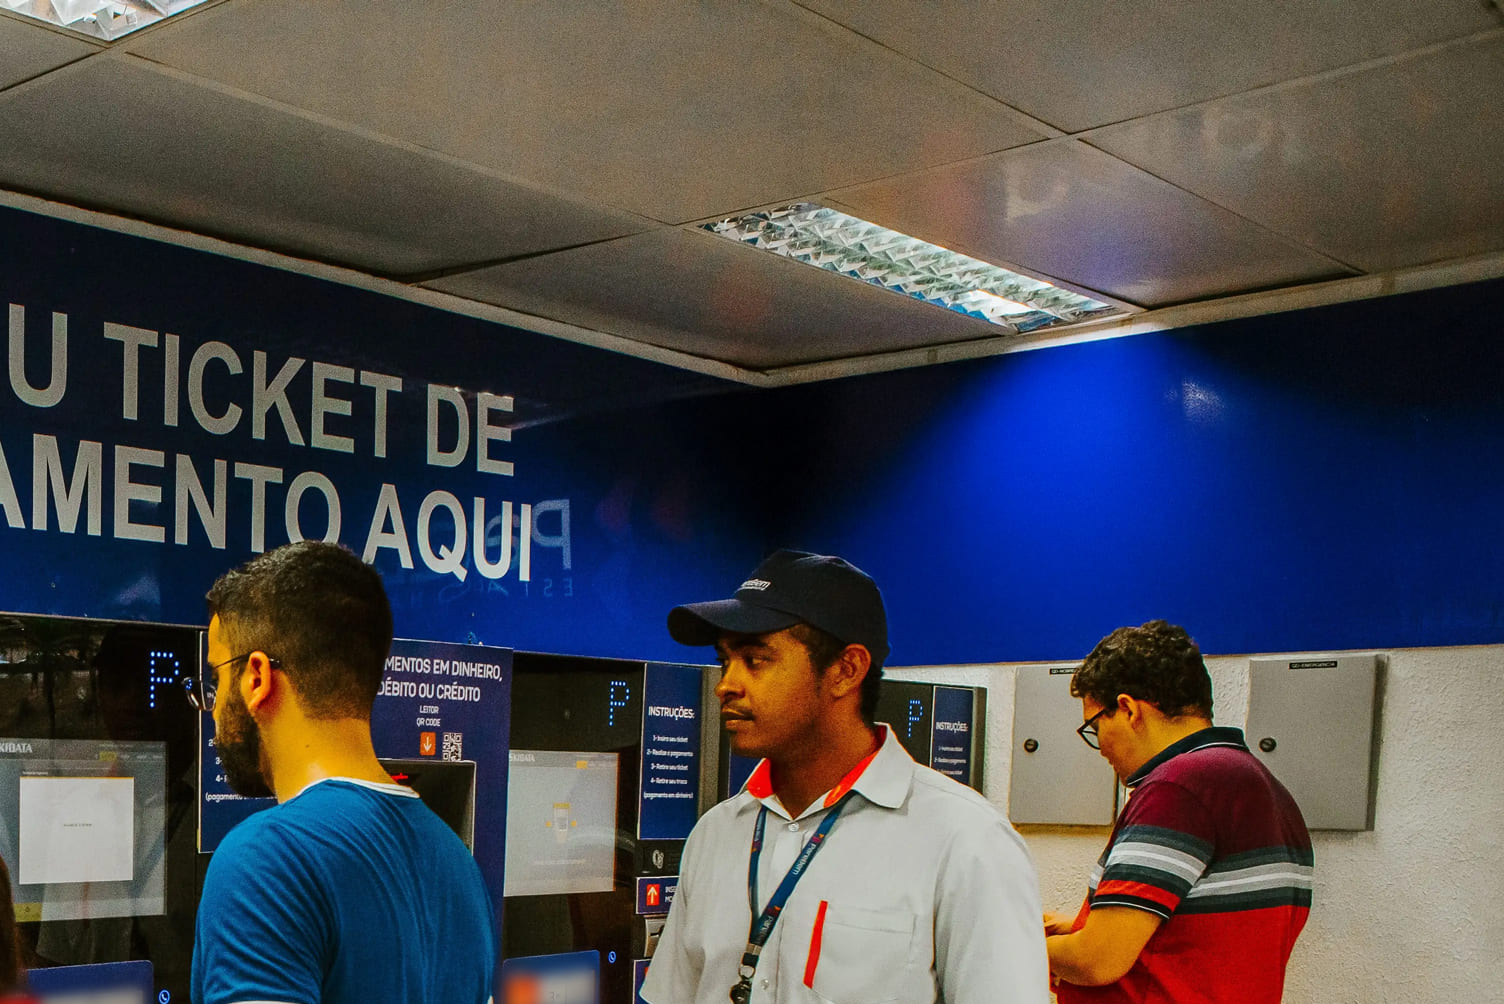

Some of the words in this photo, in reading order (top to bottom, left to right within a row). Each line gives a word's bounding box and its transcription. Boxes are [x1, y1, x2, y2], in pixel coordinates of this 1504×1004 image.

[103, 321, 403, 459] TICKET
[426, 383, 516, 477] DE
[362, 483, 532, 583] AQUI
[150, 651, 180, 709] P
[384, 656, 431, 674] MENTOS
[433, 659, 450, 676] EM
[451, 661, 503, 682] DINHEIRO,
[419, 683, 435, 699] OU
[436, 681, 481, 702] CRÉDITO
[608, 681, 630, 727] P
[416, 717, 425, 727] QR
[426, 718, 441, 727] CODE
[419, 705, 439, 714] LEITOR
[648, 706, 695, 720] INSTRUÇÕES:
[908, 700, 923, 738] P
